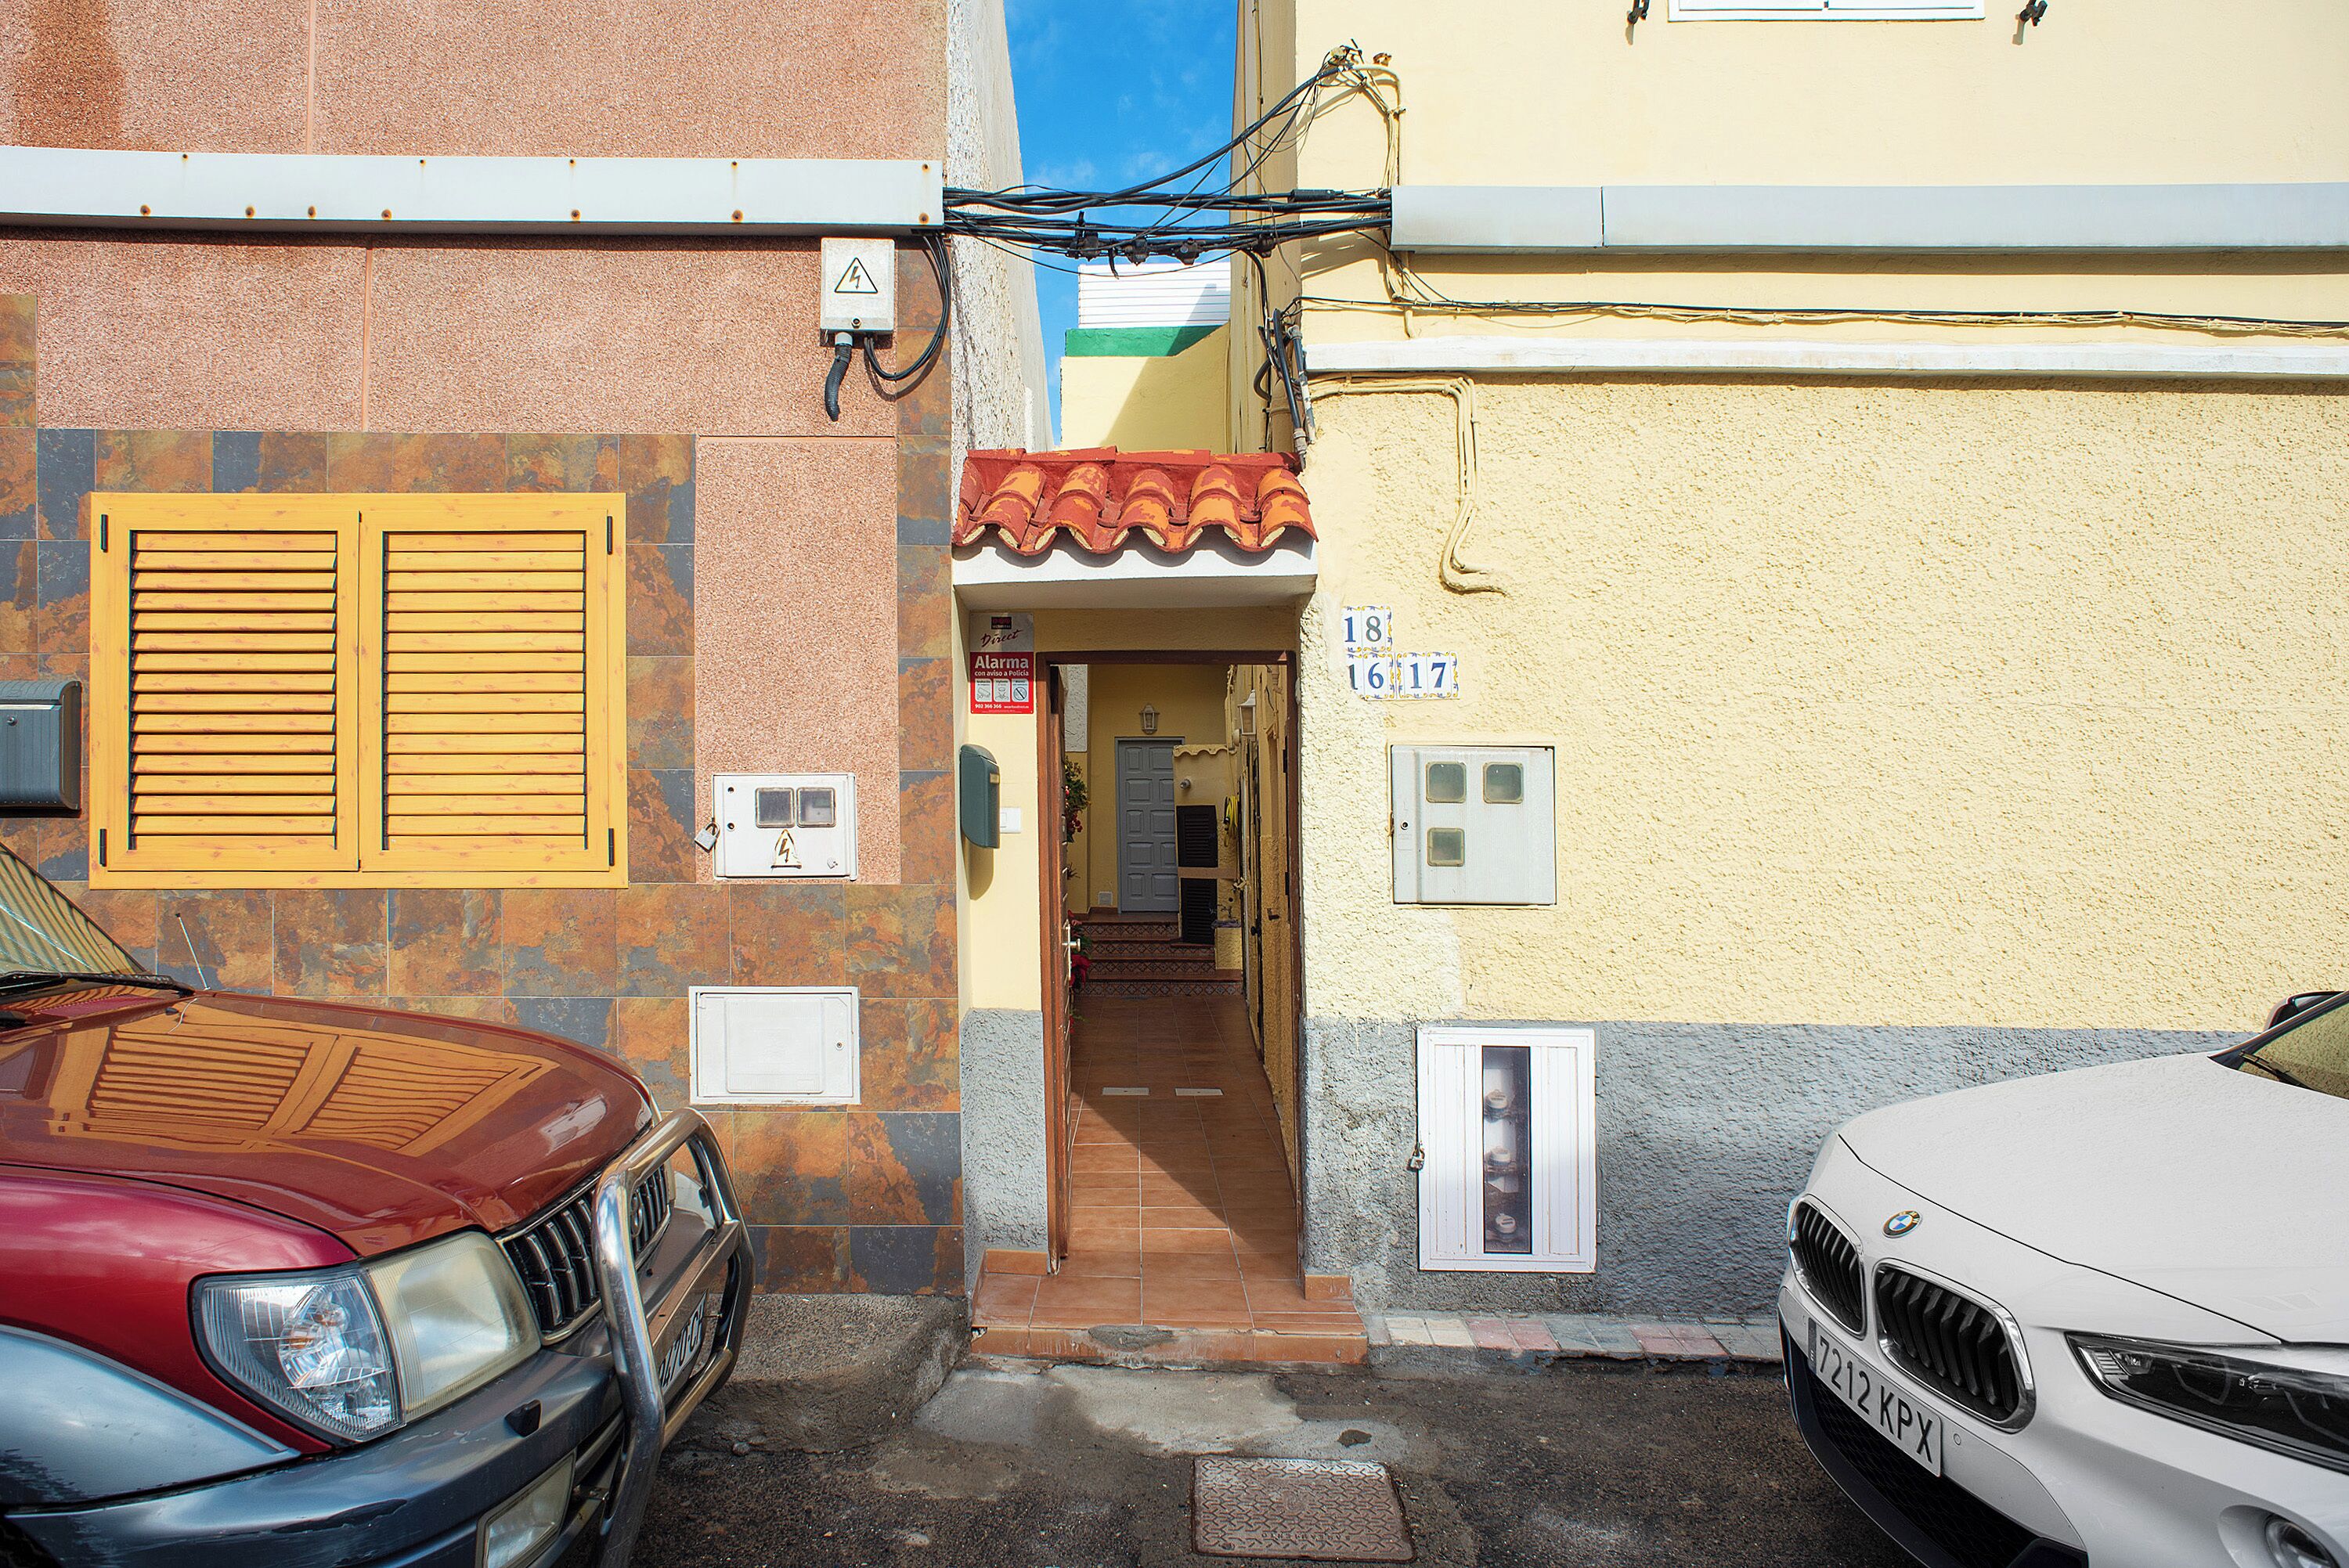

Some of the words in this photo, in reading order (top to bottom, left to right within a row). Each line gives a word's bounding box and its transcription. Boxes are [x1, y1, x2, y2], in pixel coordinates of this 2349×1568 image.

[980, 629, 1023, 647] Direct
[1344, 615, 1382, 642] 18
[975, 654, 1029, 669] Alarma
[1348, 662, 1384, 690] 16
[1409, 662, 1447, 689] 17
[1820, 1335, 1871, 1416] 7212
[1880, 1384, 1932, 1464] KPX
